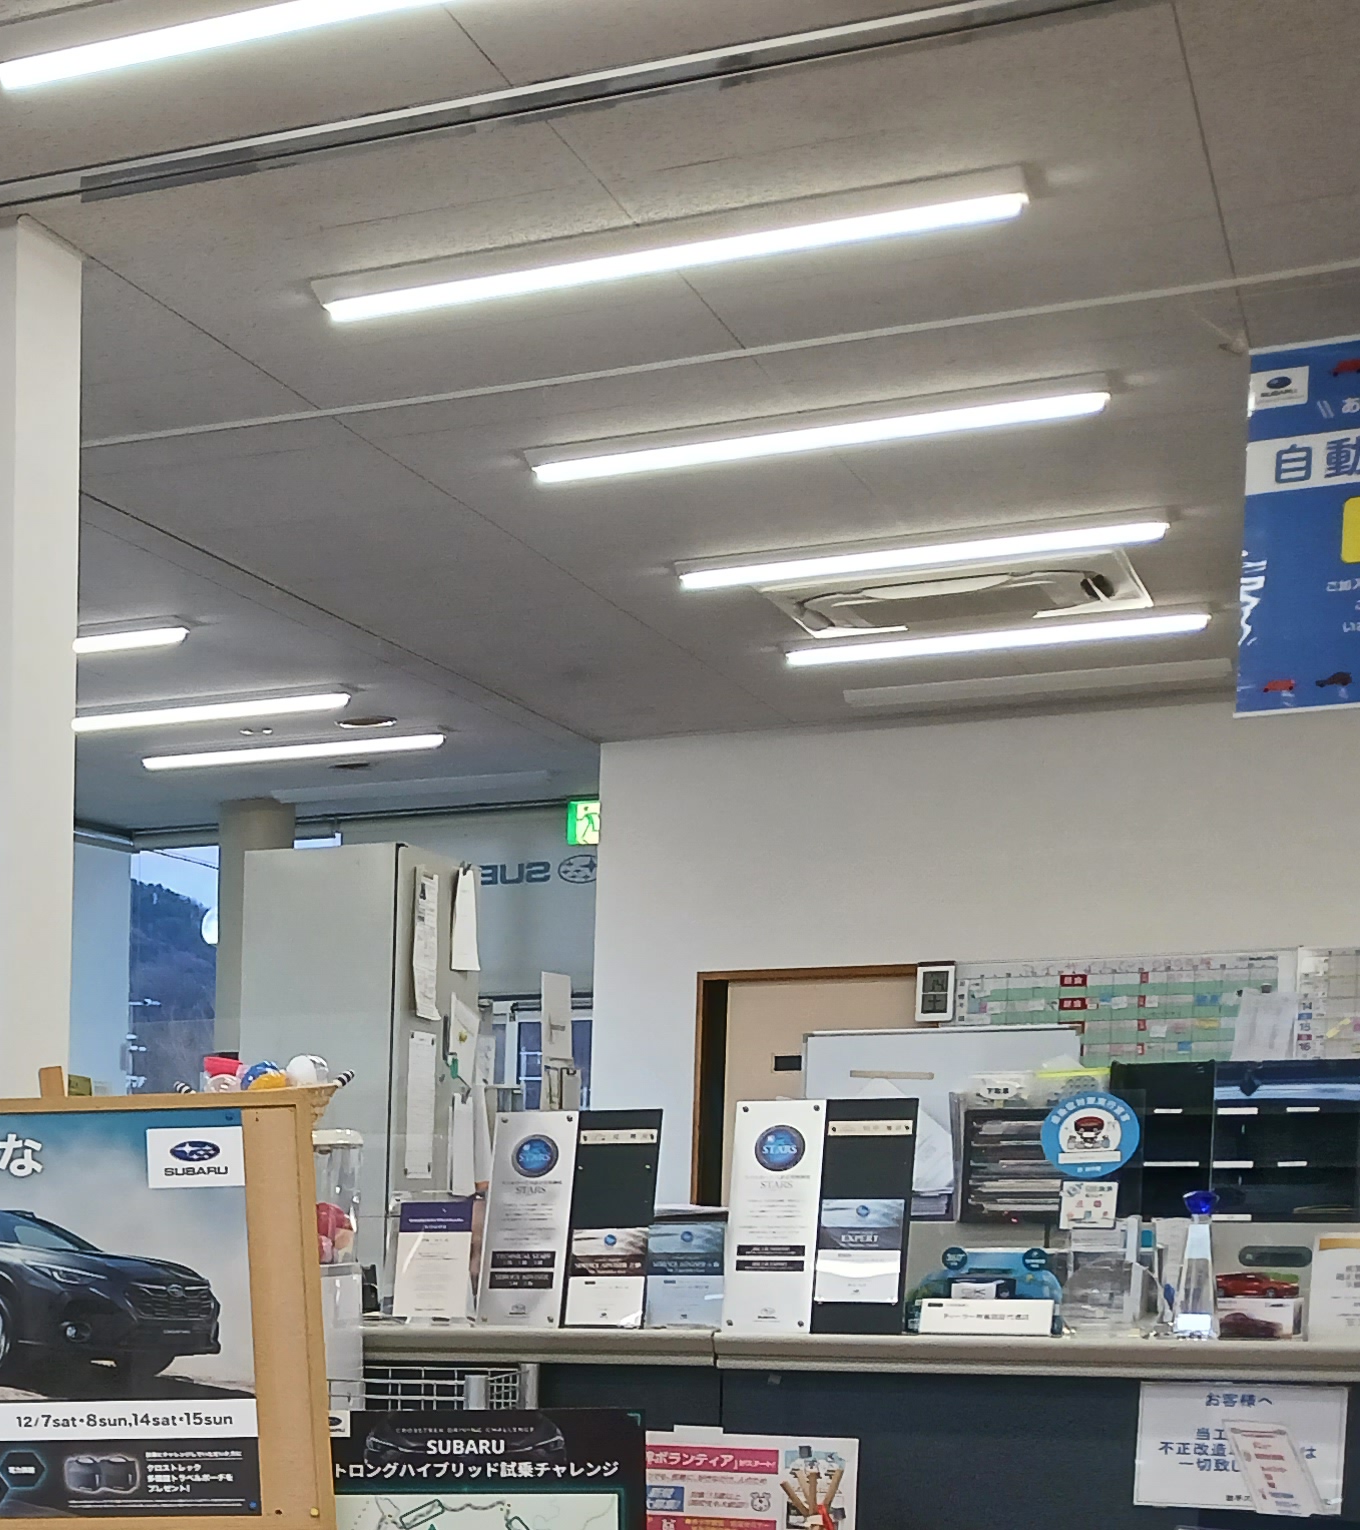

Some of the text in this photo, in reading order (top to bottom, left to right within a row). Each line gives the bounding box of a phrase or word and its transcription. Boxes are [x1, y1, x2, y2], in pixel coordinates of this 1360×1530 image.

[762, 1145, 797, 1154] STARS
[164, 1166, 228, 1176] SUBARU
[760, 1180, 793, 1189] STARS
[1205, 1392, 1273, 1407] お客様へ
[426, 1439, 505, 1455] SUBARU
[1158, 1441, 1235, 1456] 不正改造
